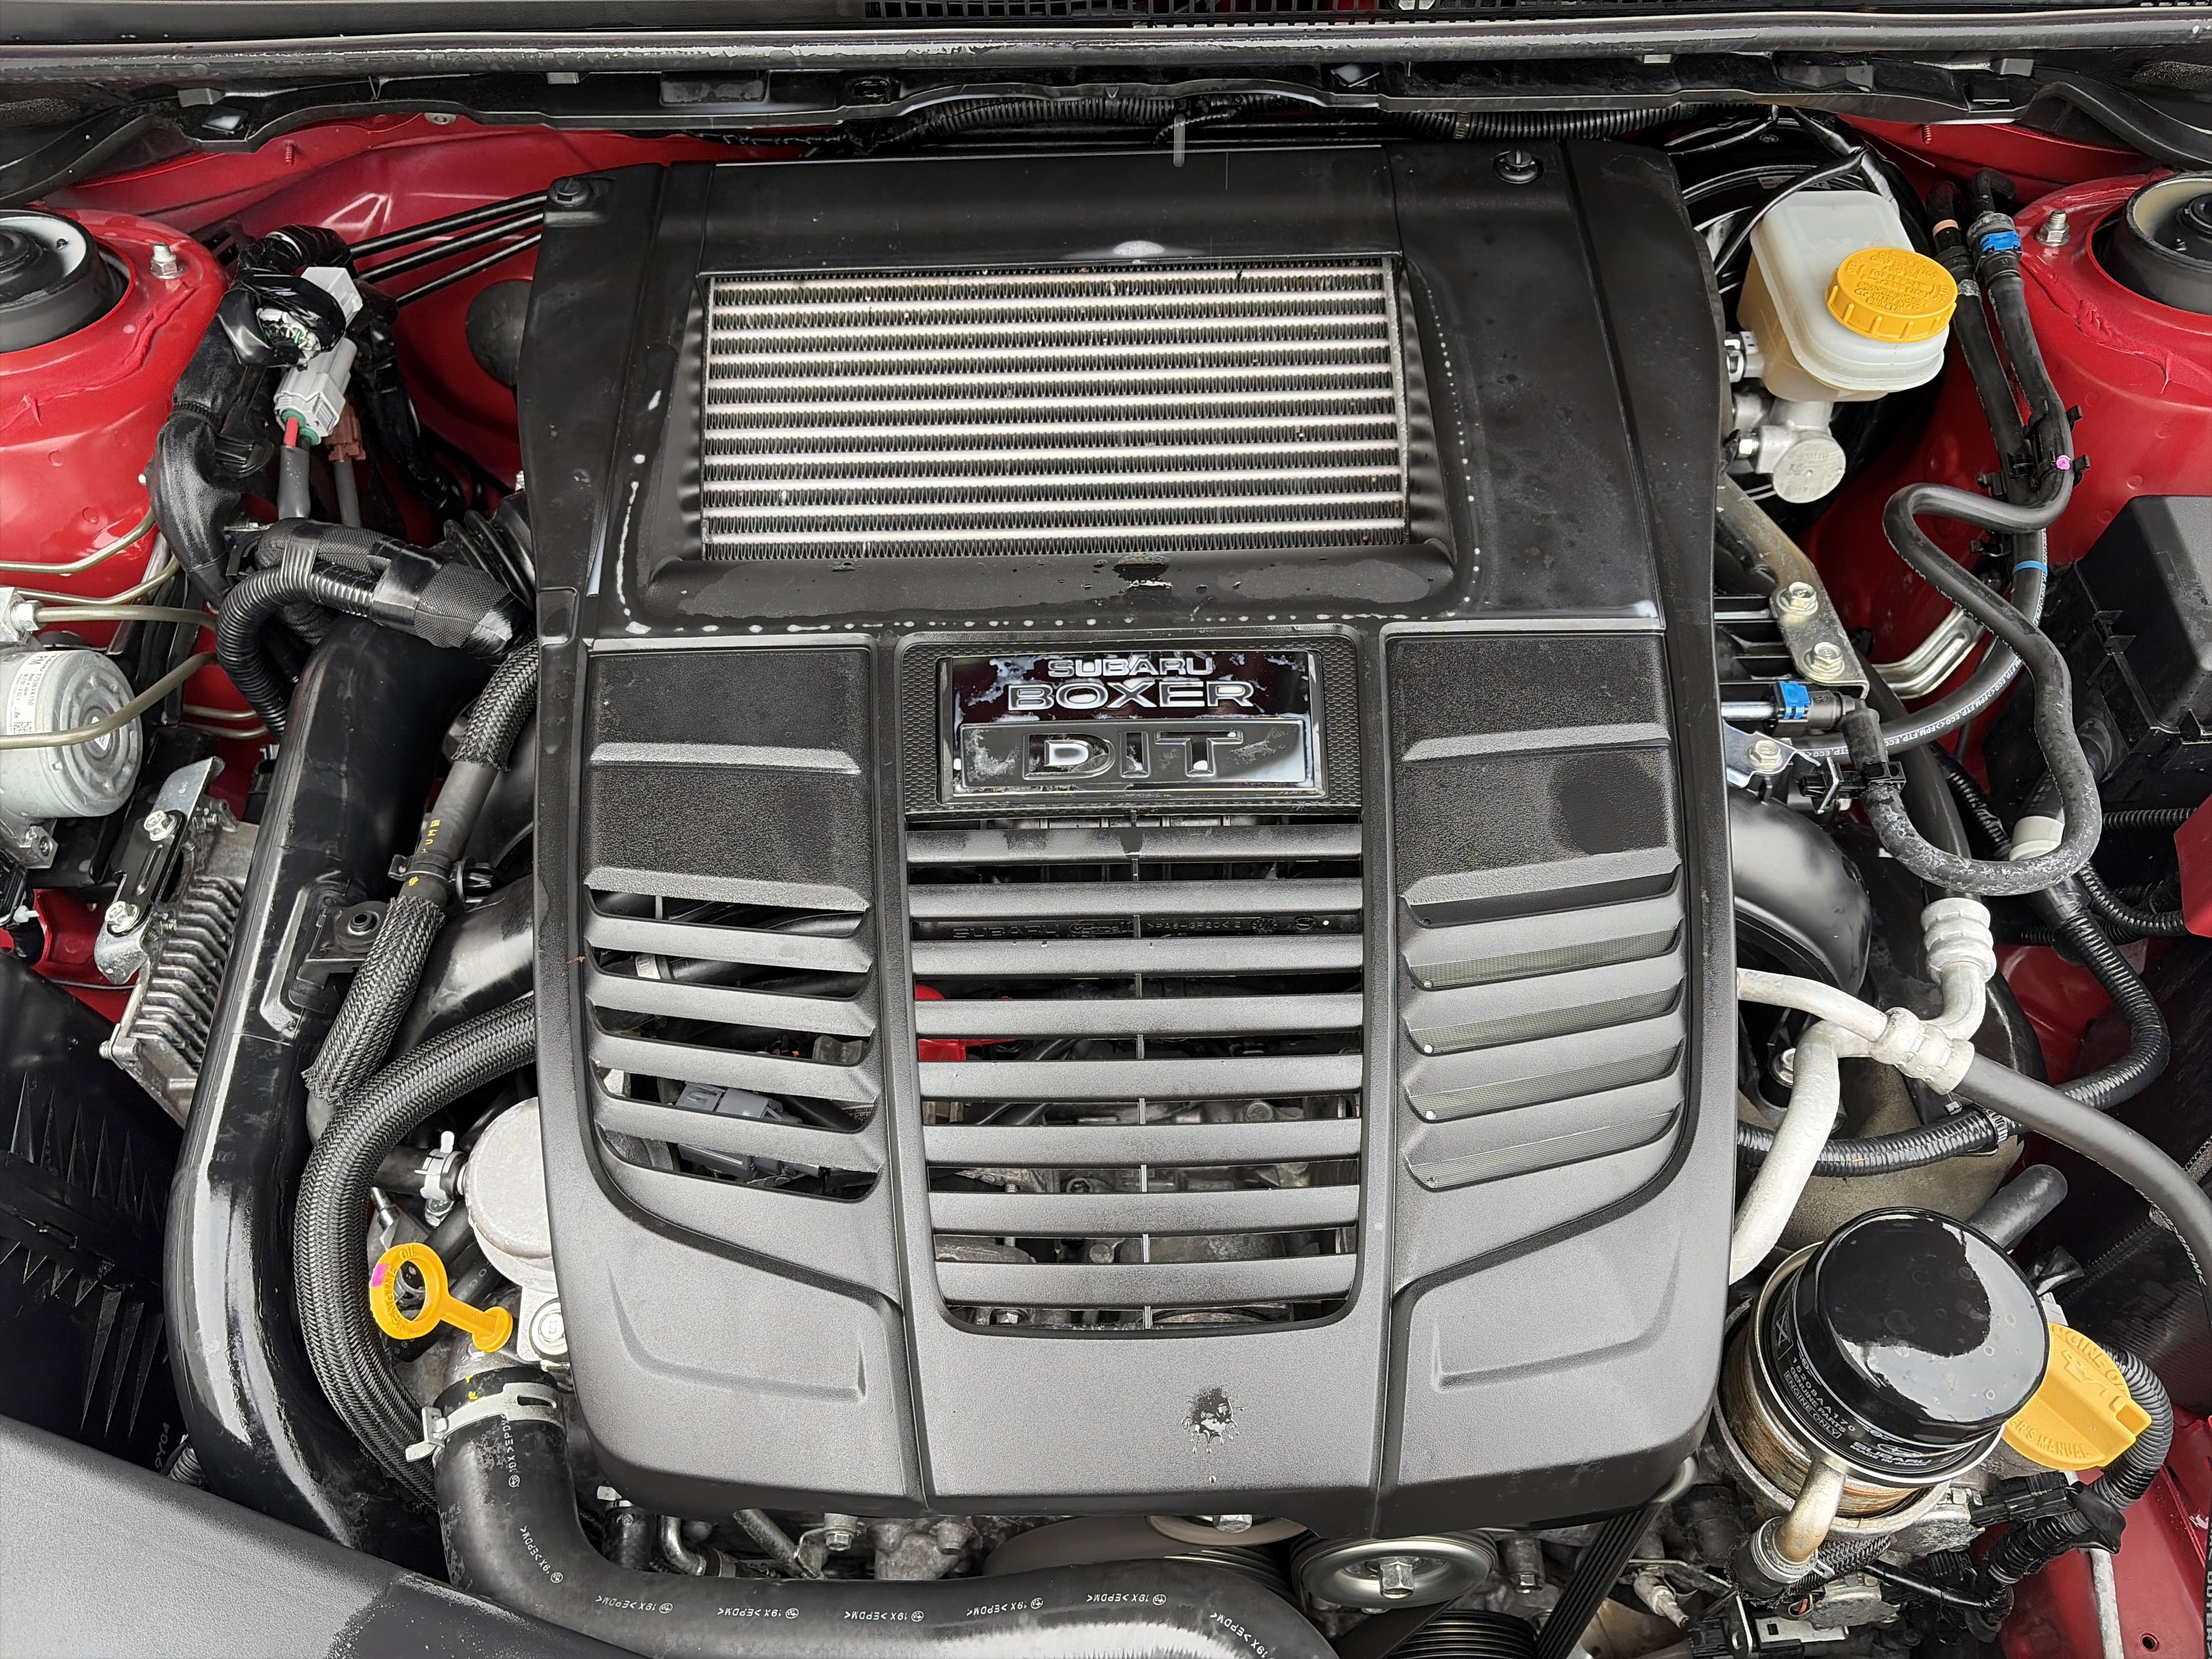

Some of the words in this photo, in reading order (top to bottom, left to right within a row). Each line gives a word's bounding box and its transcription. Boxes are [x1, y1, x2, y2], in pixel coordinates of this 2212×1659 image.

[1854, 288, 1872, 297] CAP
[1858, 281, 1895, 298] REMOVING
[1866, 297, 1904, 313] WARNING
[1872, 294, 1897, 307] FILLER
[1048, 657, 1212, 677] SUBARU
[1008, 681, 1254, 710] BOXER
[1023, 730, 1243, 780] DIT
[399, 1245, 419, 1260] OIL
[1785, 1373, 1812, 1412] ENGINE
[1813, 1413, 1838, 1436] ONLY
[1791, 1367, 1819, 1408] GENUINE
[1818, 1407, 1846, 1432] PARTS
[1793, 1357, 1855, 1432] 15208AA170
[1849, 1445, 1879, 1459] MADE
[1853, 1442, 1932, 1464] SUBARU
[2038, 1435, 2091, 1458] MANUAL
